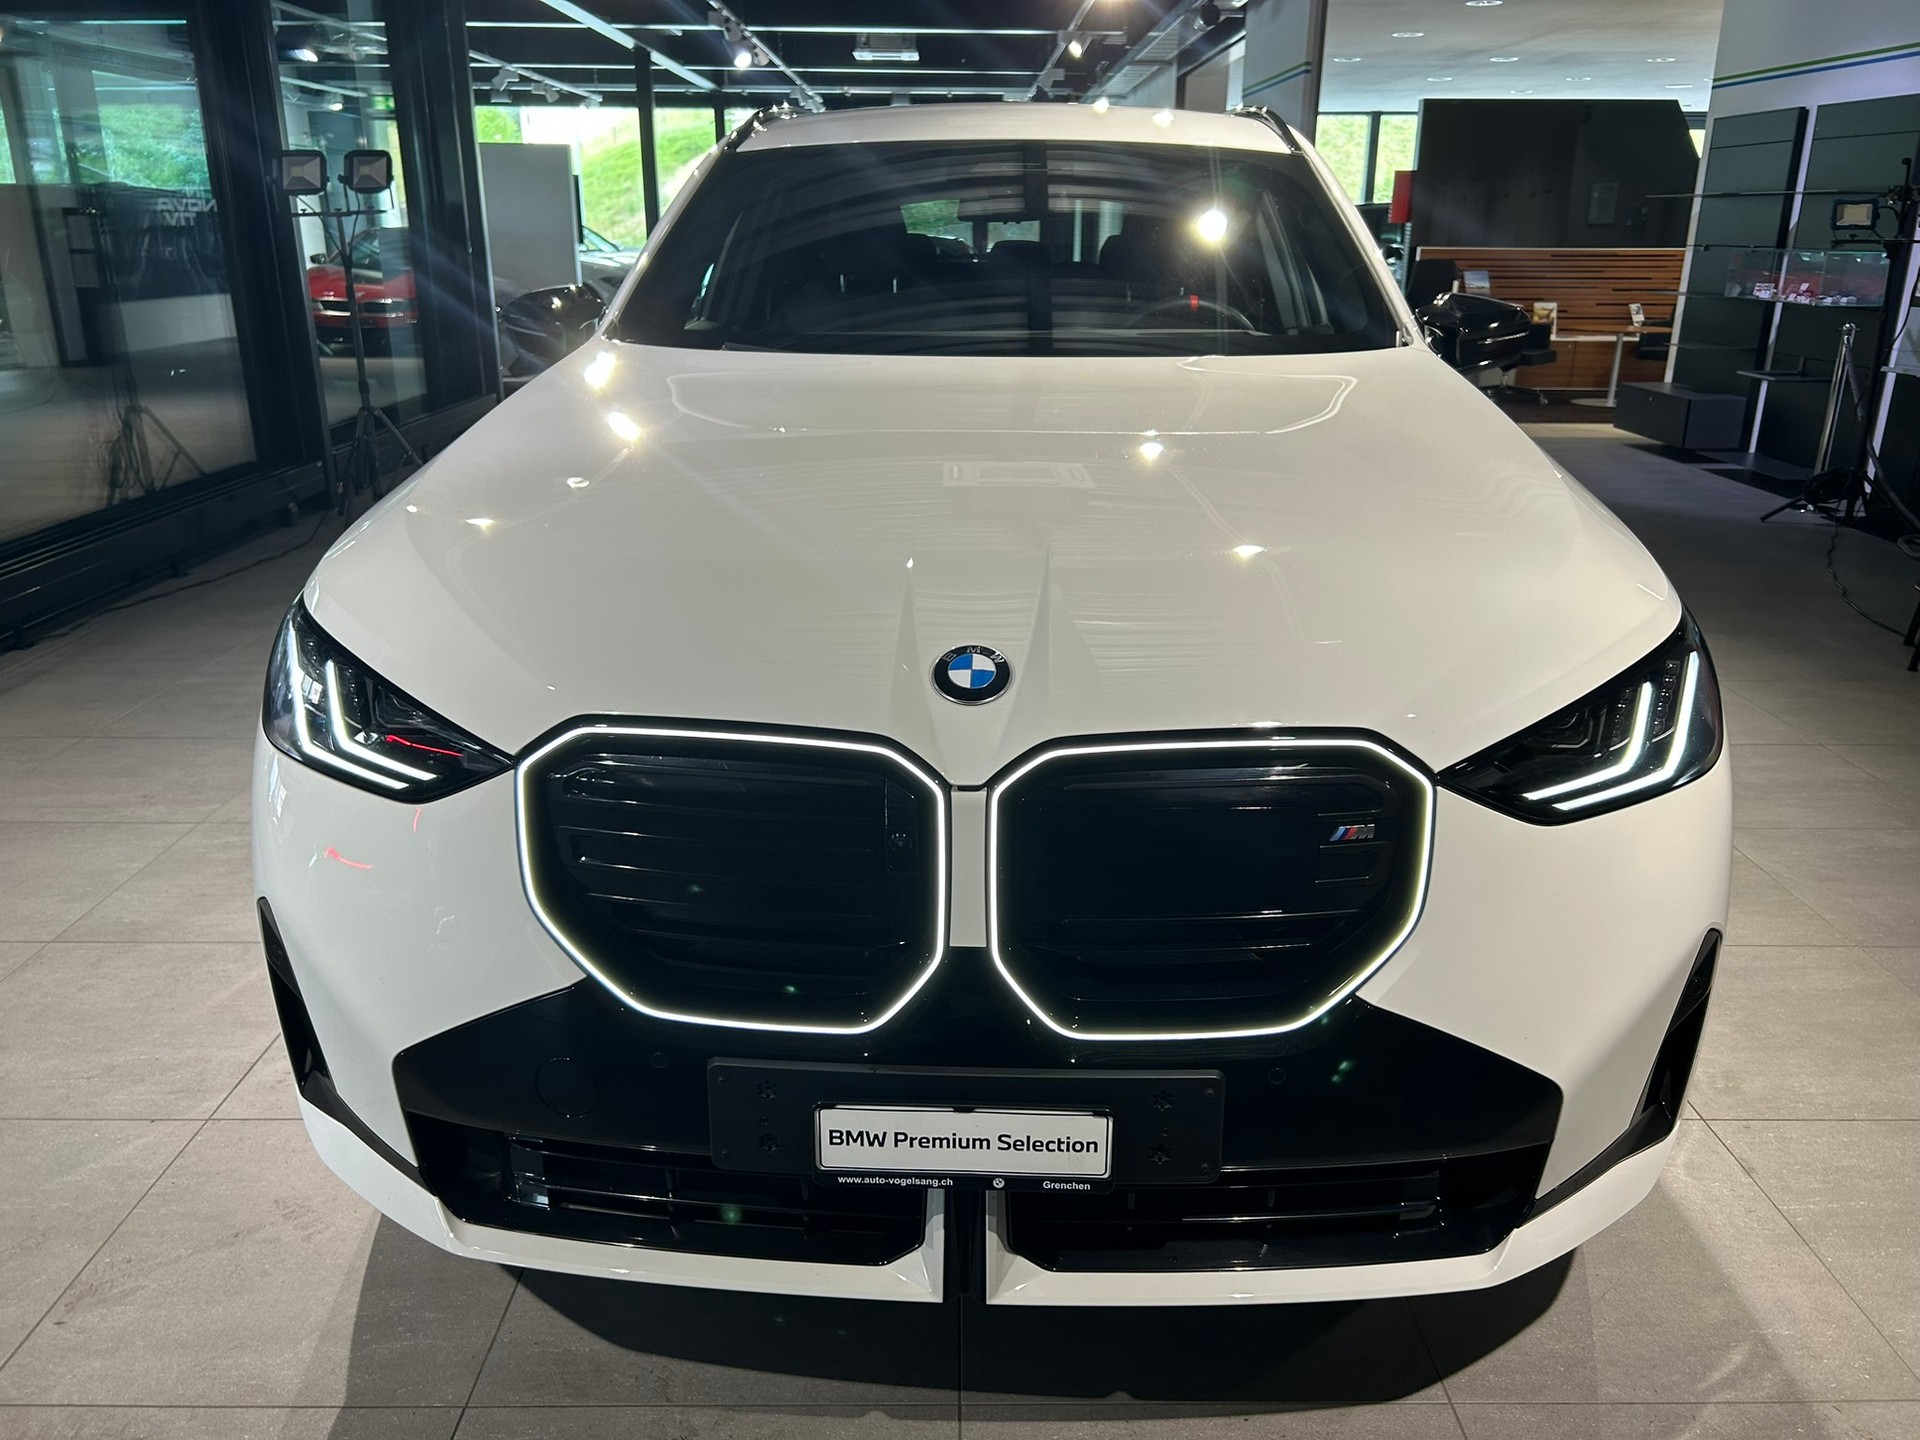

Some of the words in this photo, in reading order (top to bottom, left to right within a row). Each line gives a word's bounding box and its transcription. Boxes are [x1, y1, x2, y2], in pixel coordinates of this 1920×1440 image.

[941, 645, 1005, 664] BMW
[828, 1129, 887, 1148] BMW
[893, 1131, 991, 1150] Premium
[997, 1134, 1099, 1153] Selection
[837, 1176, 953, 1187] www.auto-vogelsang.ch
[1043, 1180, 1091, 1191] Grenchen
